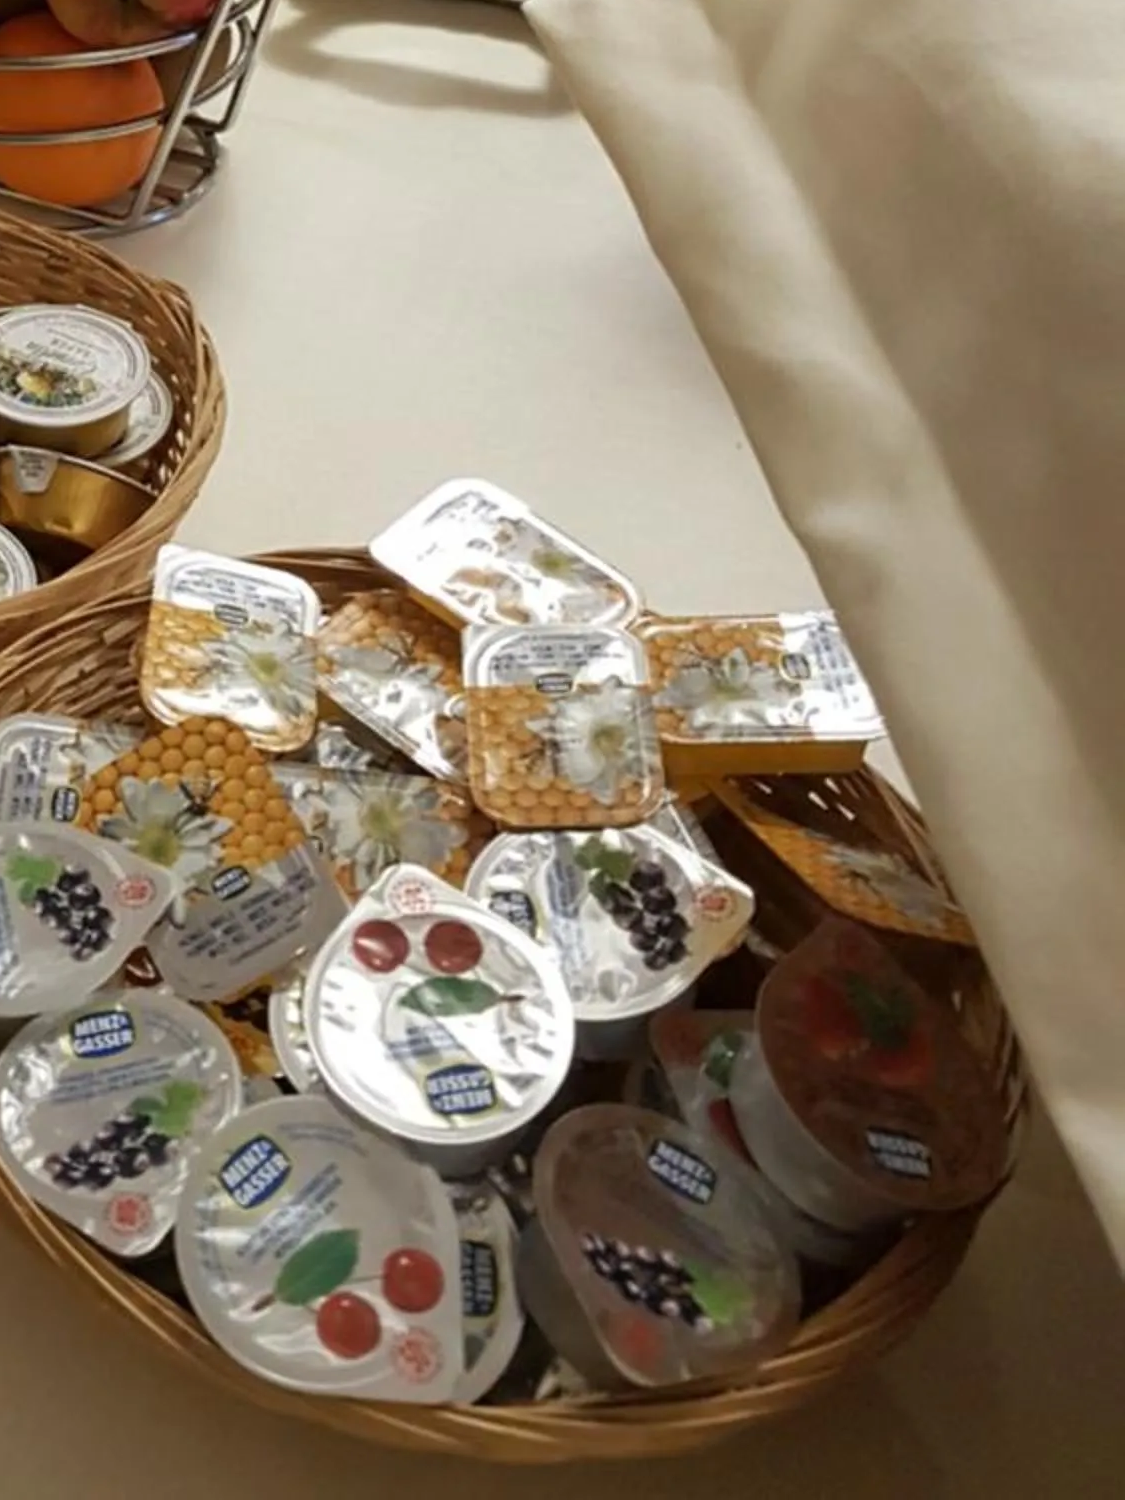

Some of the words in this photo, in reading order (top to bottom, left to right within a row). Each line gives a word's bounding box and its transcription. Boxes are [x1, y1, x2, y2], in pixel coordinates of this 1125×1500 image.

[74, 1029, 133, 1054] GASSER
[427, 1069, 492, 1095] GASSER
[233, 1150, 289, 1206] GASSER
